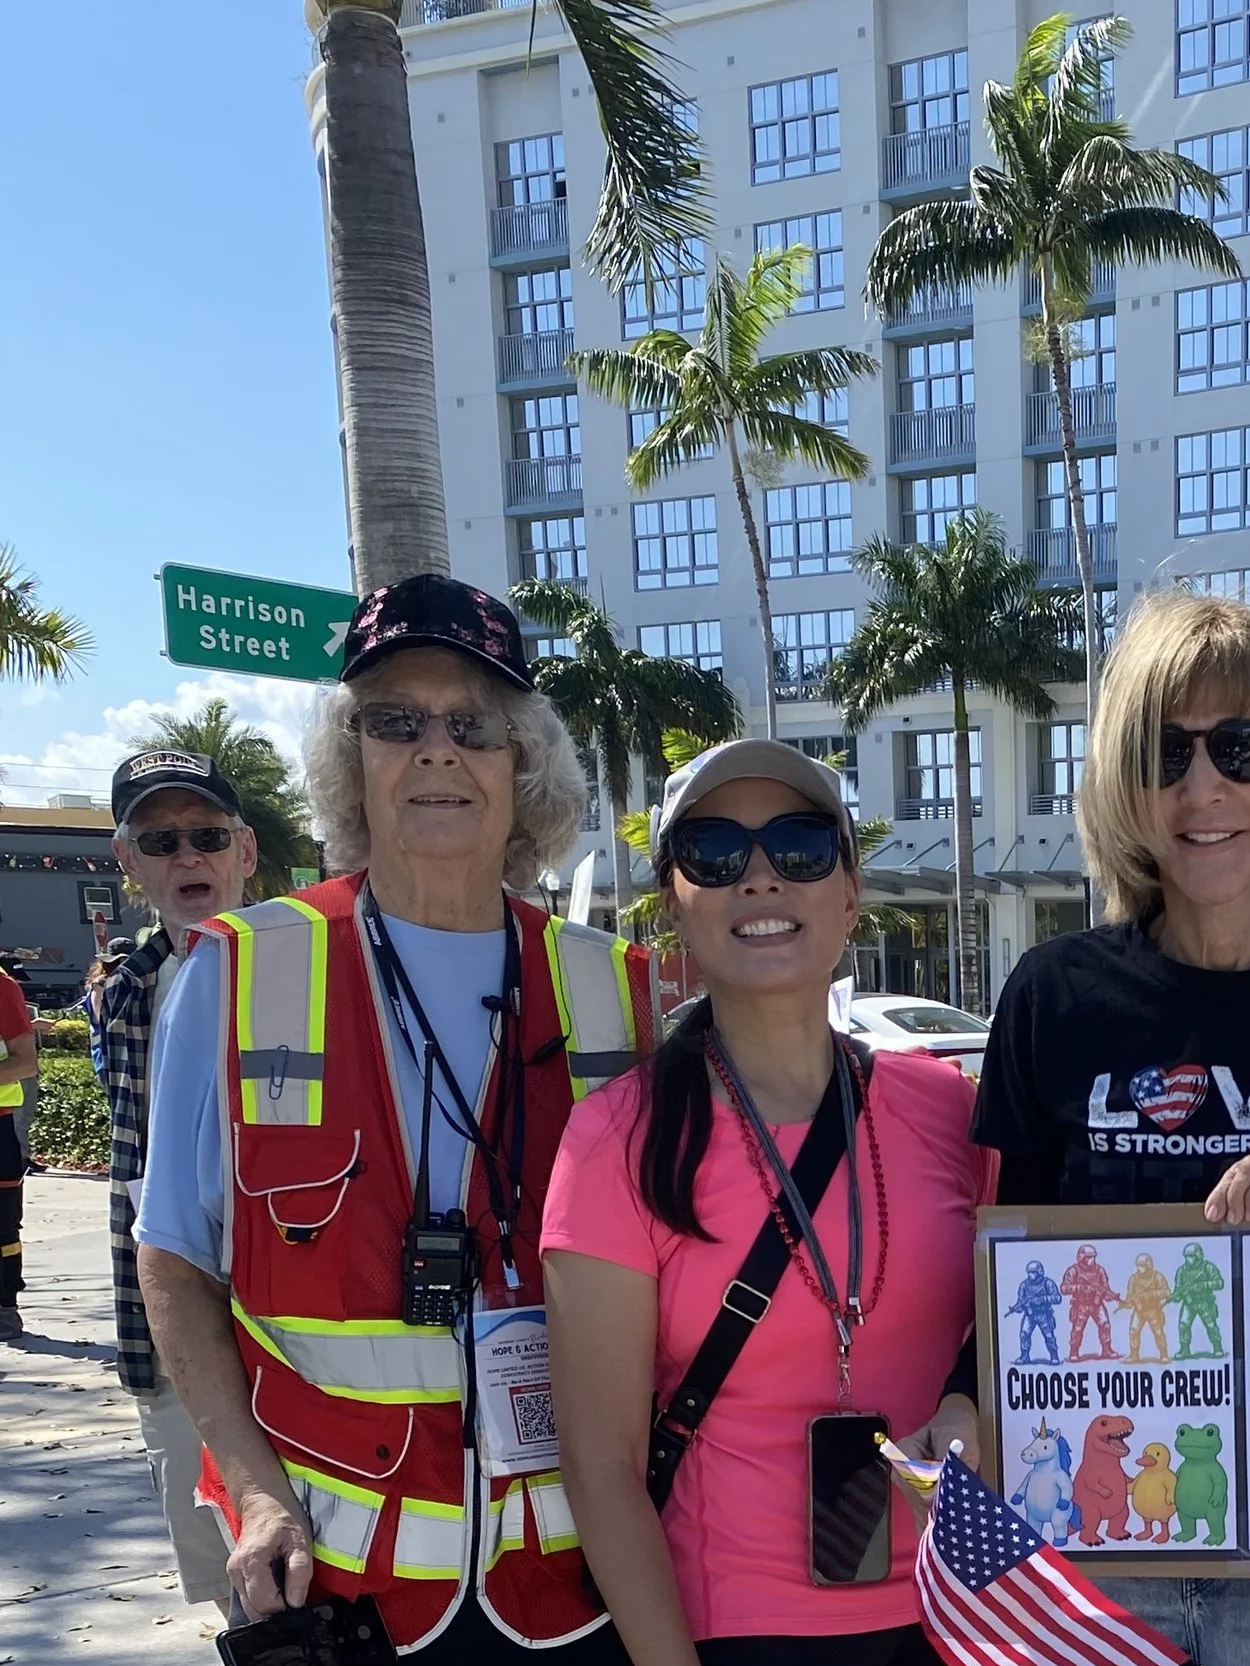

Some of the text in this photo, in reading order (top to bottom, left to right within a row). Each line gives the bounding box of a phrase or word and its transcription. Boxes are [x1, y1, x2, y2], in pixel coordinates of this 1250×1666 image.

[177, 584, 305, 628] Harrison
[199, 625, 290, 661] Street
[1089, 1132, 1109, 1152] IS
[491, 1342, 549, 1357] HOPE & ACTIO
[1007, 1363, 1230, 1411] CHOOSE YOUR CREW!
